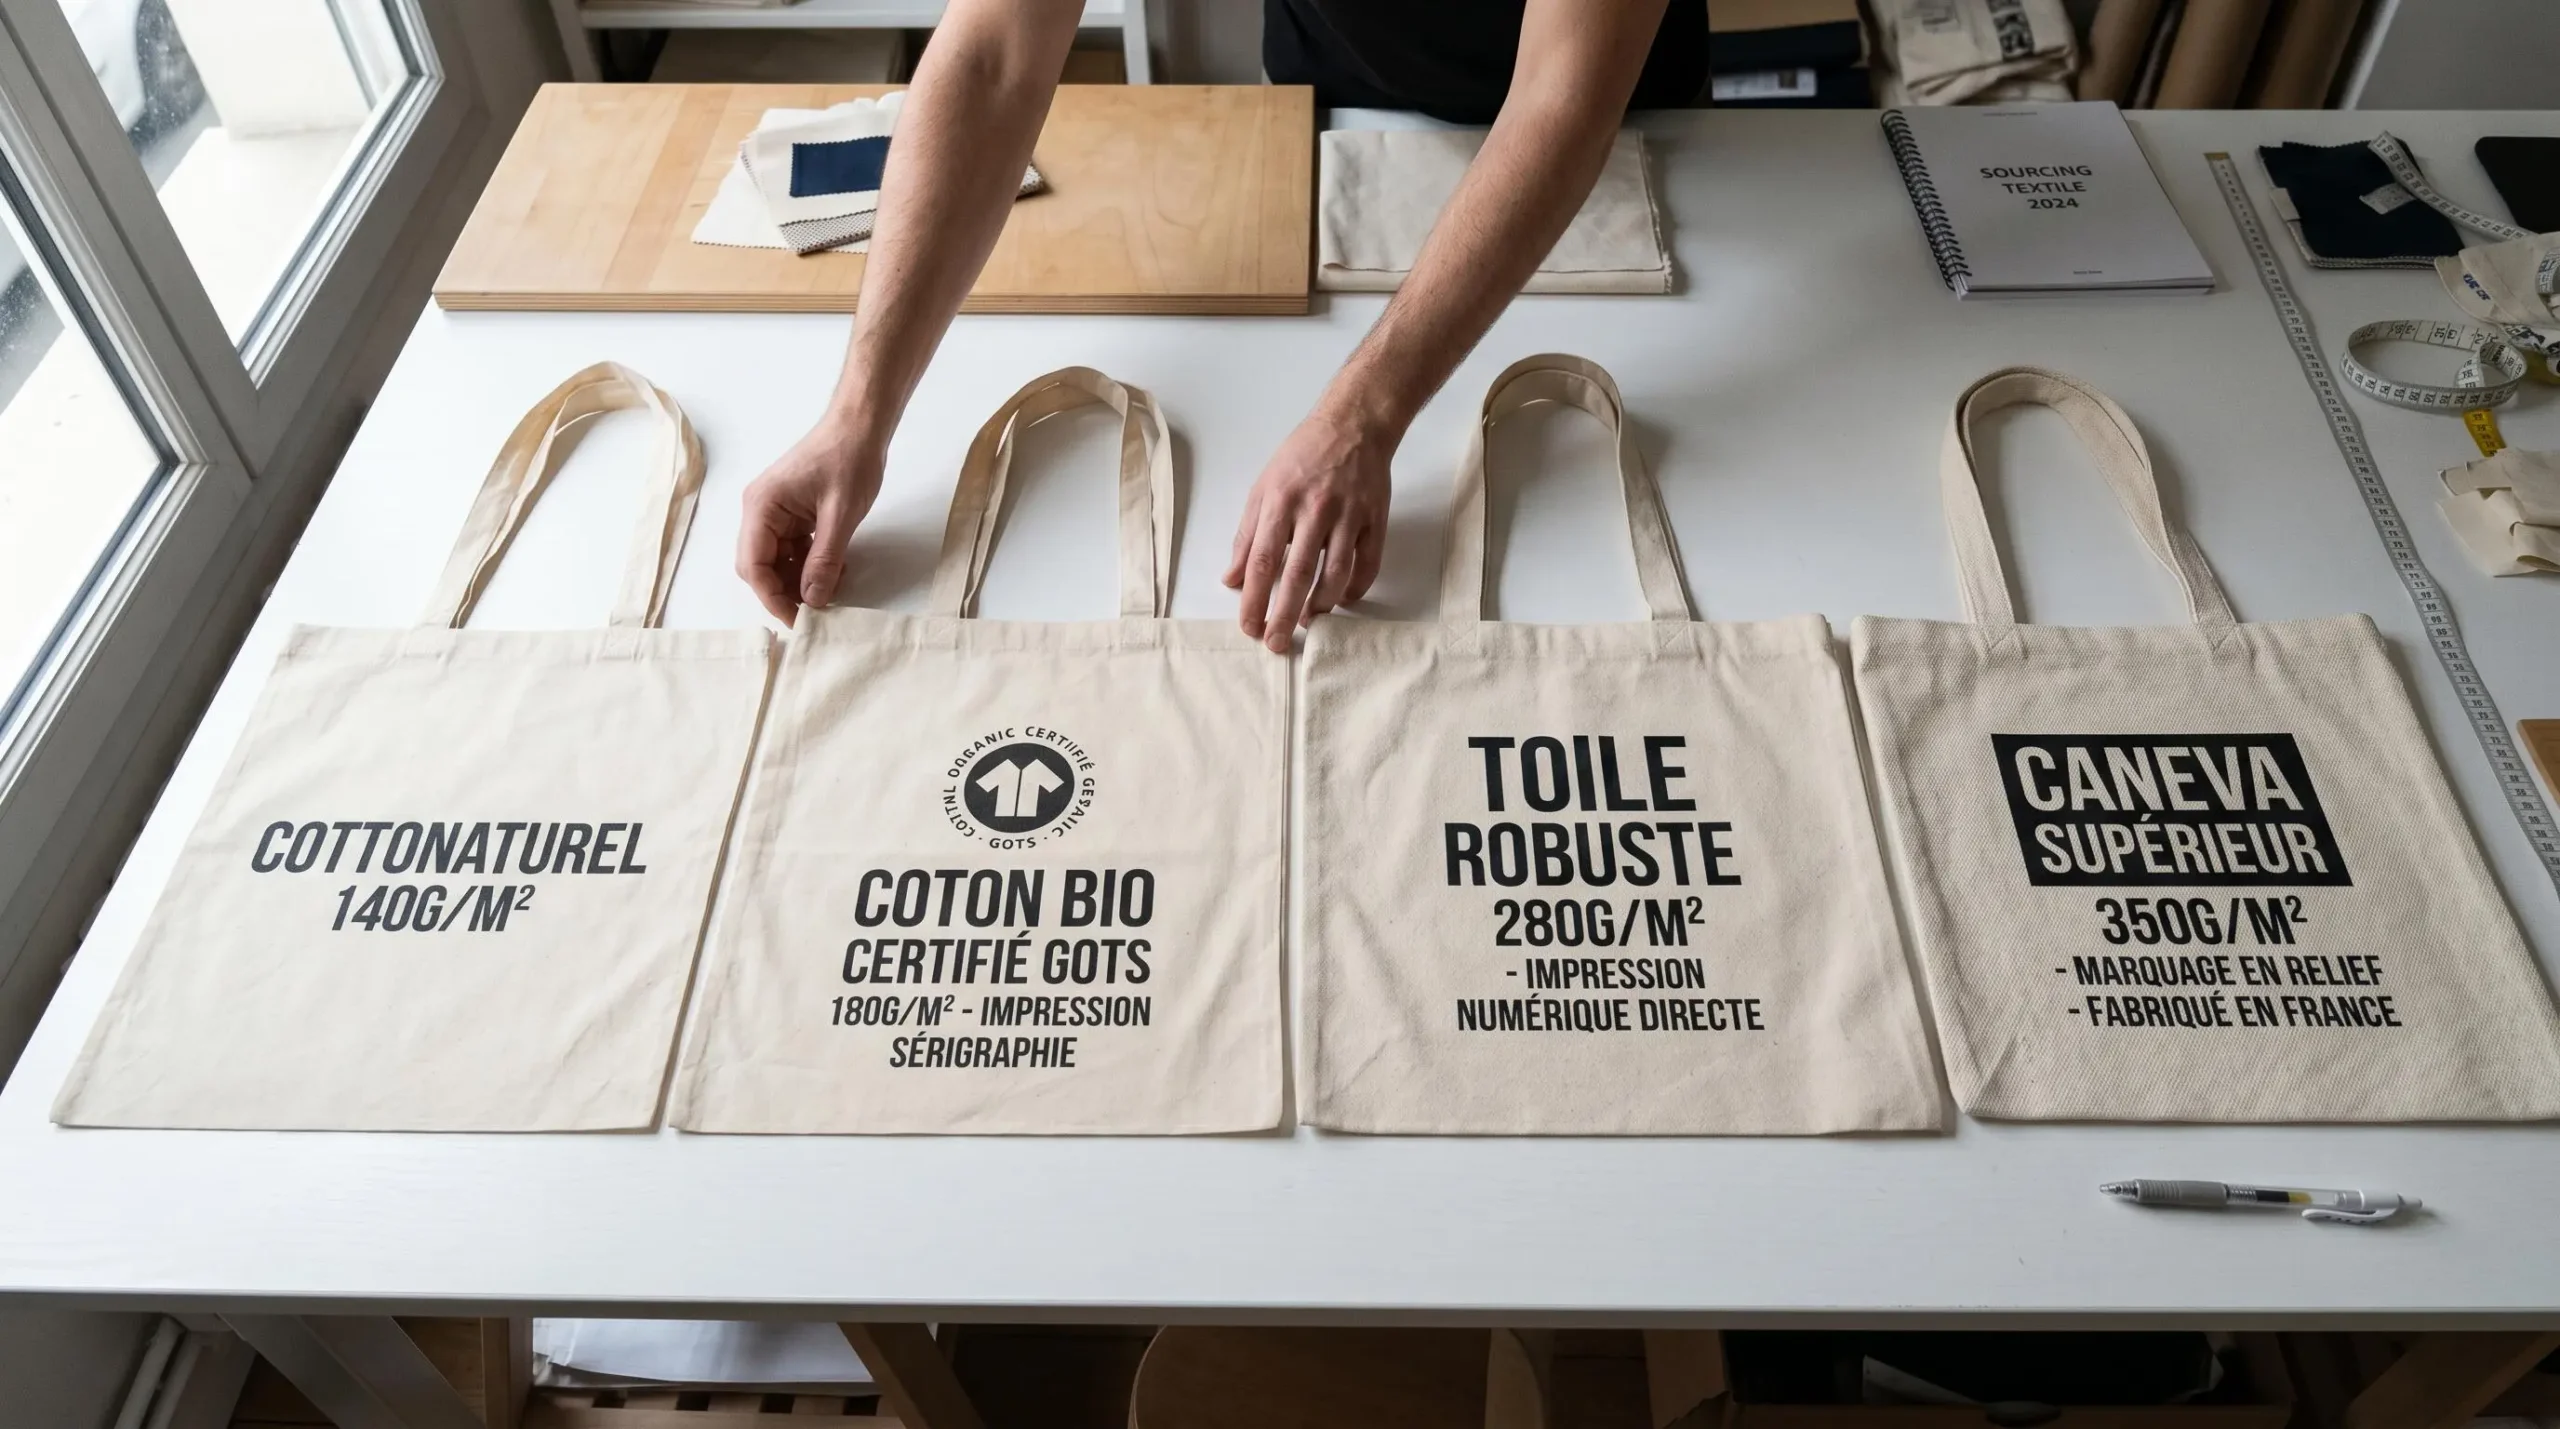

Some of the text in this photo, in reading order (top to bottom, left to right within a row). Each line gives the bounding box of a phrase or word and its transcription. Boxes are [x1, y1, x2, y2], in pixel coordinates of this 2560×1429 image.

[1980, 165, 2092, 179] SOURCING
[2002, 182, 2087, 194] TEXTILE
[2028, 197, 2079, 210] 2024
[1468, 735, 1697, 812] TOILE
[2014, 746, 2304, 812] CANEVA
[251, 821, 647, 875] COTTONATUREL
[989, 837, 1036, 849] GOTS
[1444, 821, 1742, 887] ROBUSTE
[2034, 813, 2329, 874] SUPÉRIEUR
[331, 884, 536, 932] 140G/M²
[854, 868, 1155, 927] COTON BIO
[1493, 896, 1705, 947] 280G/M²
[2095, 895, 2308, 945] 350G/M²
[842, 930, 1152, 985] CERTIFIÉ GOTS
[1526, 958, 1706, 989] IMPRESSION
[2073, 955, 2237, 987] MARQUAGE
[2239, 956, 2281, 986] EN
[2286, 955, 2383, 986] RELIEF
[832, 994, 955, 1026] 180G/M²
[980, 996, 1151, 1026] IMPRESSION
[1457, 993, 1765, 1033] NUMÉRIQUE DIRECTE
[2087, 990, 2234, 1029] FABRIQUÉ
[2236, 996, 2279, 1027] EN
[2283, 996, 2402, 1027] FRANCE
[889, 1031, 1078, 1068] SÉRIGRAPHIE
